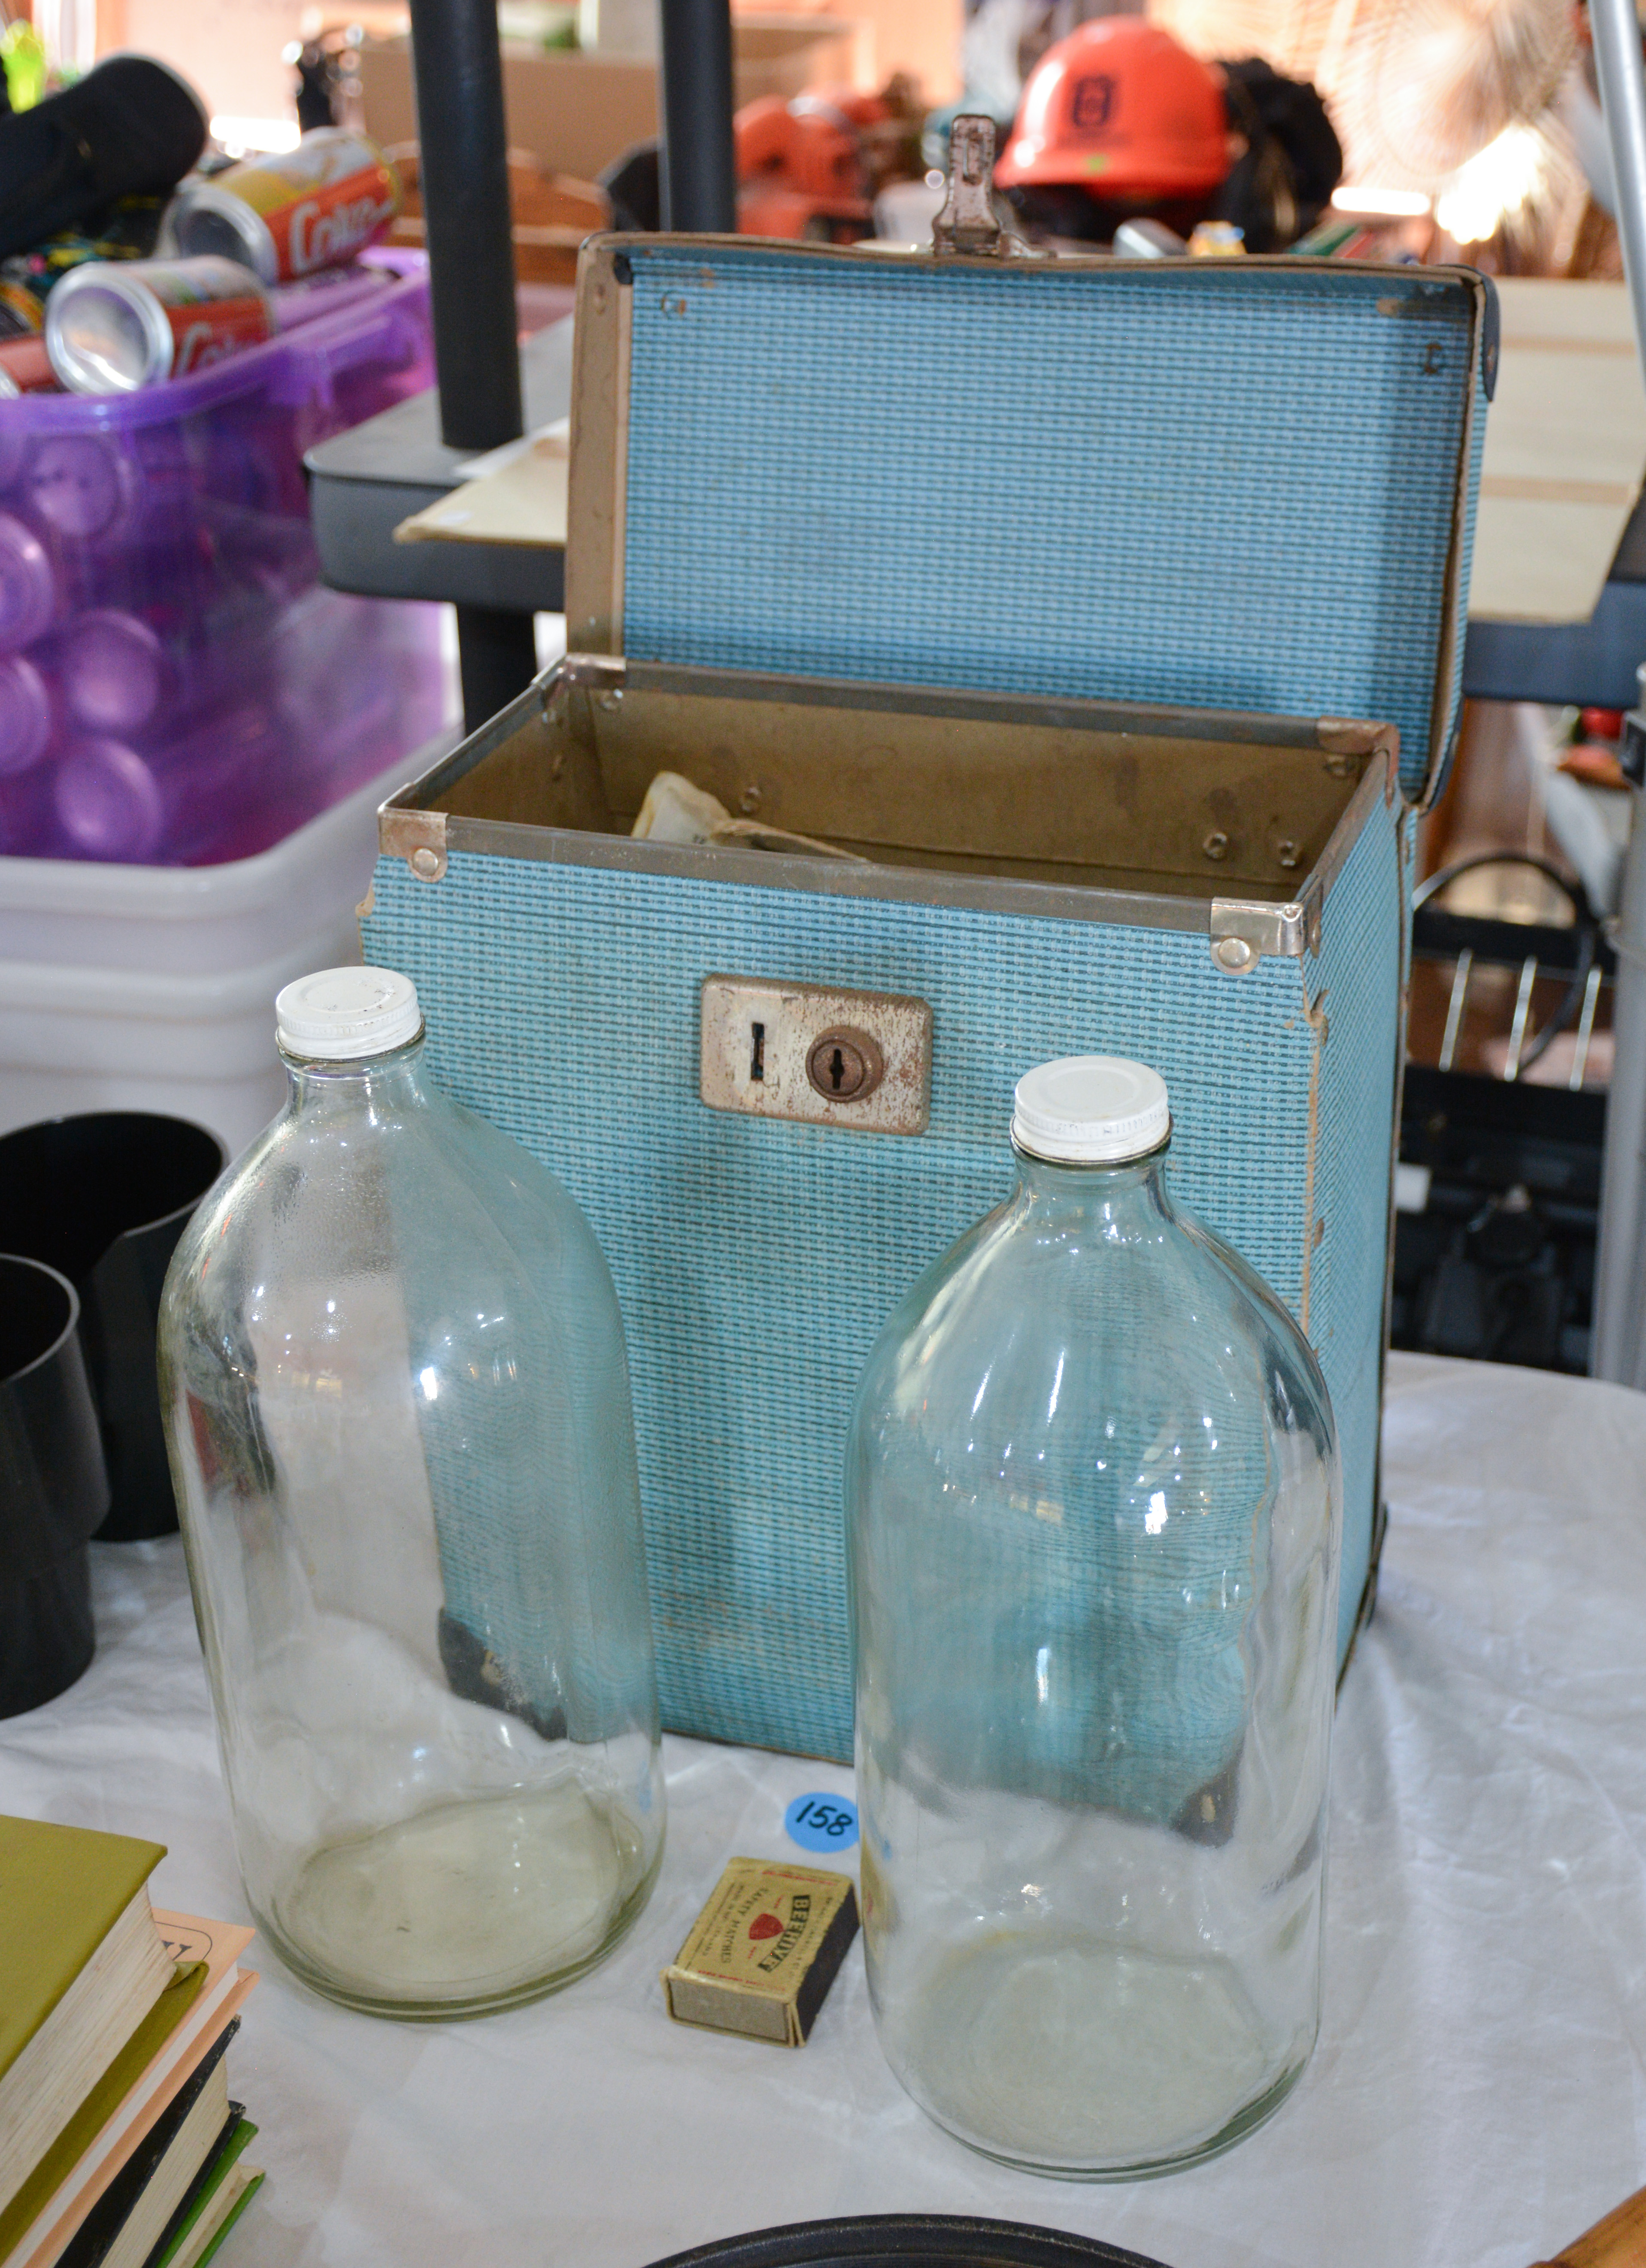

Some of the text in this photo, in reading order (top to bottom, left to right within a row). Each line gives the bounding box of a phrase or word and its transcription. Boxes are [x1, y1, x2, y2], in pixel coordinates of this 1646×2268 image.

[796, 1801, 853, 1836] 158
[738, 1888, 768, 1916] SAFETY
[721, 1919, 740, 1963] MATCHES
[760, 1899, 809, 1971] BEEHIVE
